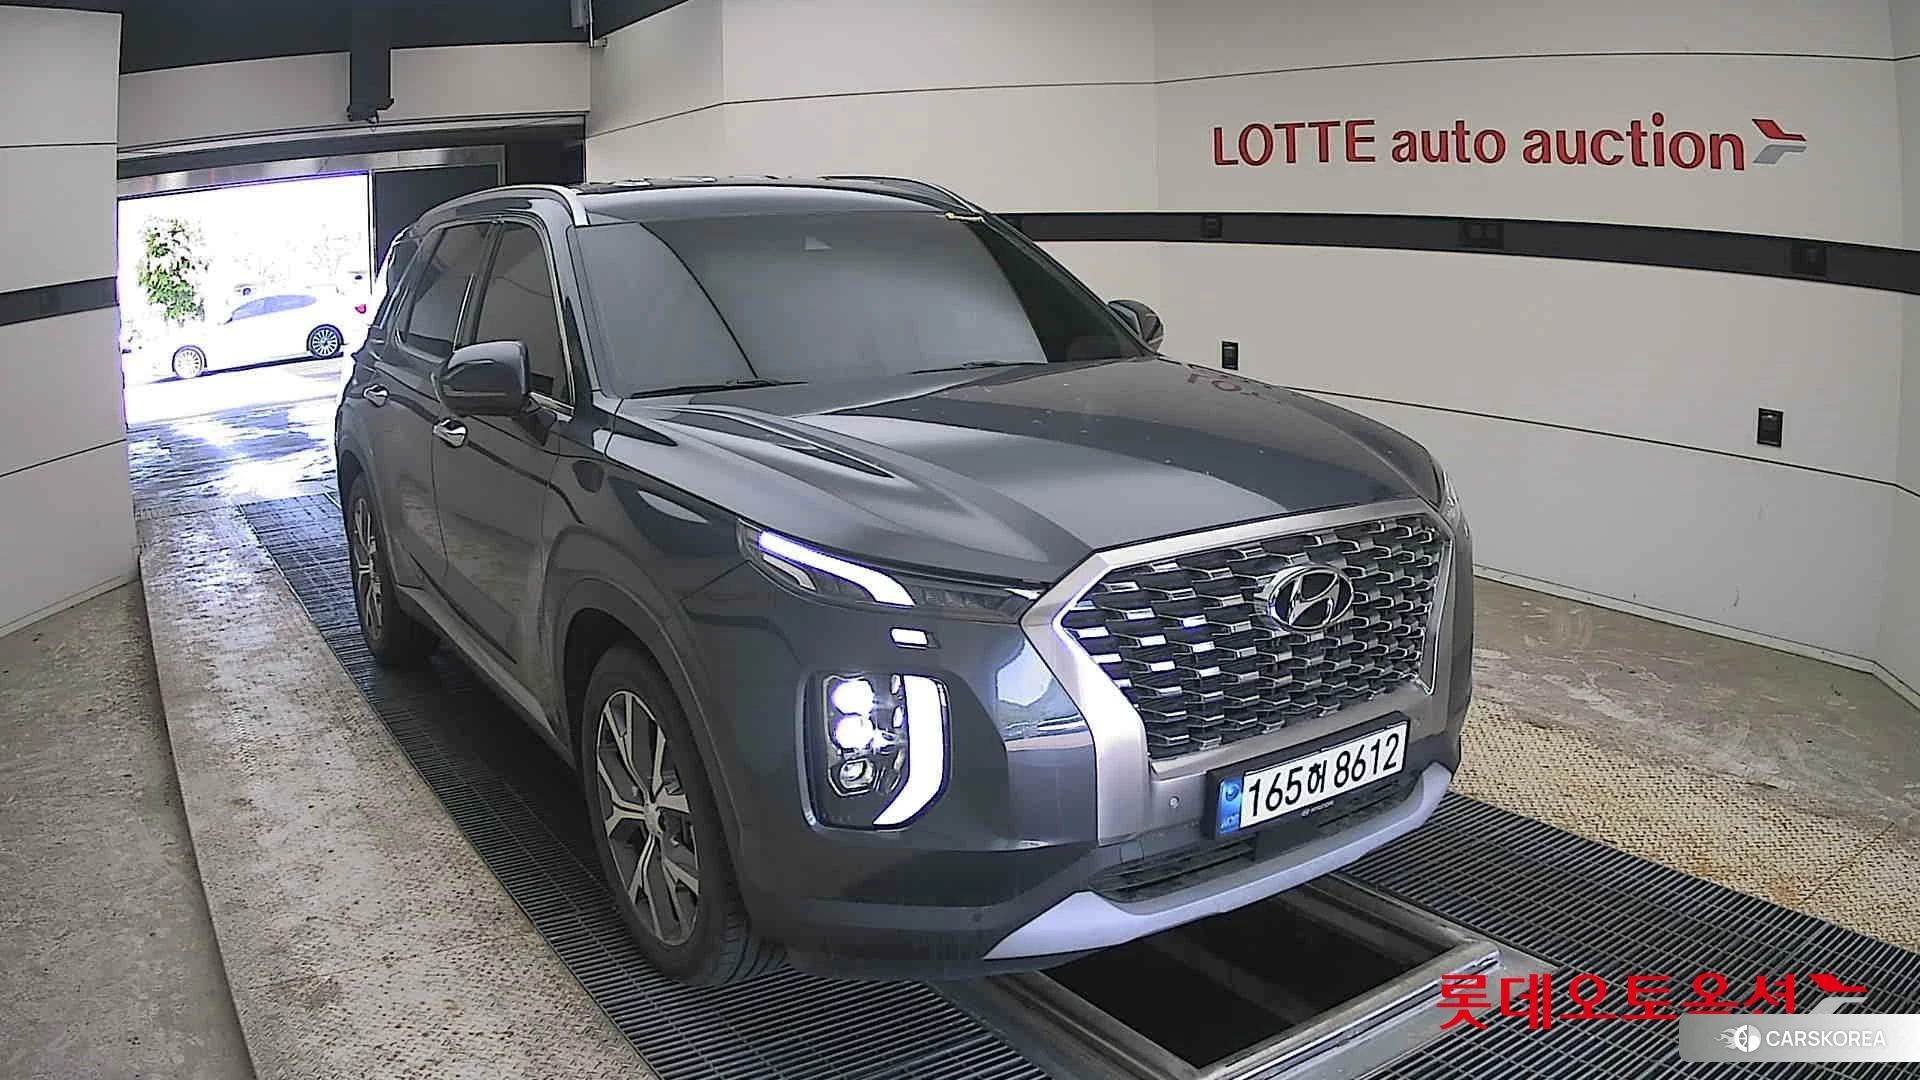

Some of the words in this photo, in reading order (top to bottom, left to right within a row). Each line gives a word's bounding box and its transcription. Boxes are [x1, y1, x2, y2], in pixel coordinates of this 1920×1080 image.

[1212, 119, 1376, 166] LOTTE
[1391, 119, 1507, 165] auto
[1521, 112, 1746, 171] auction
[1248, 759, 1328, 818] 165허
[1333, 733, 1400, 789] 8612
